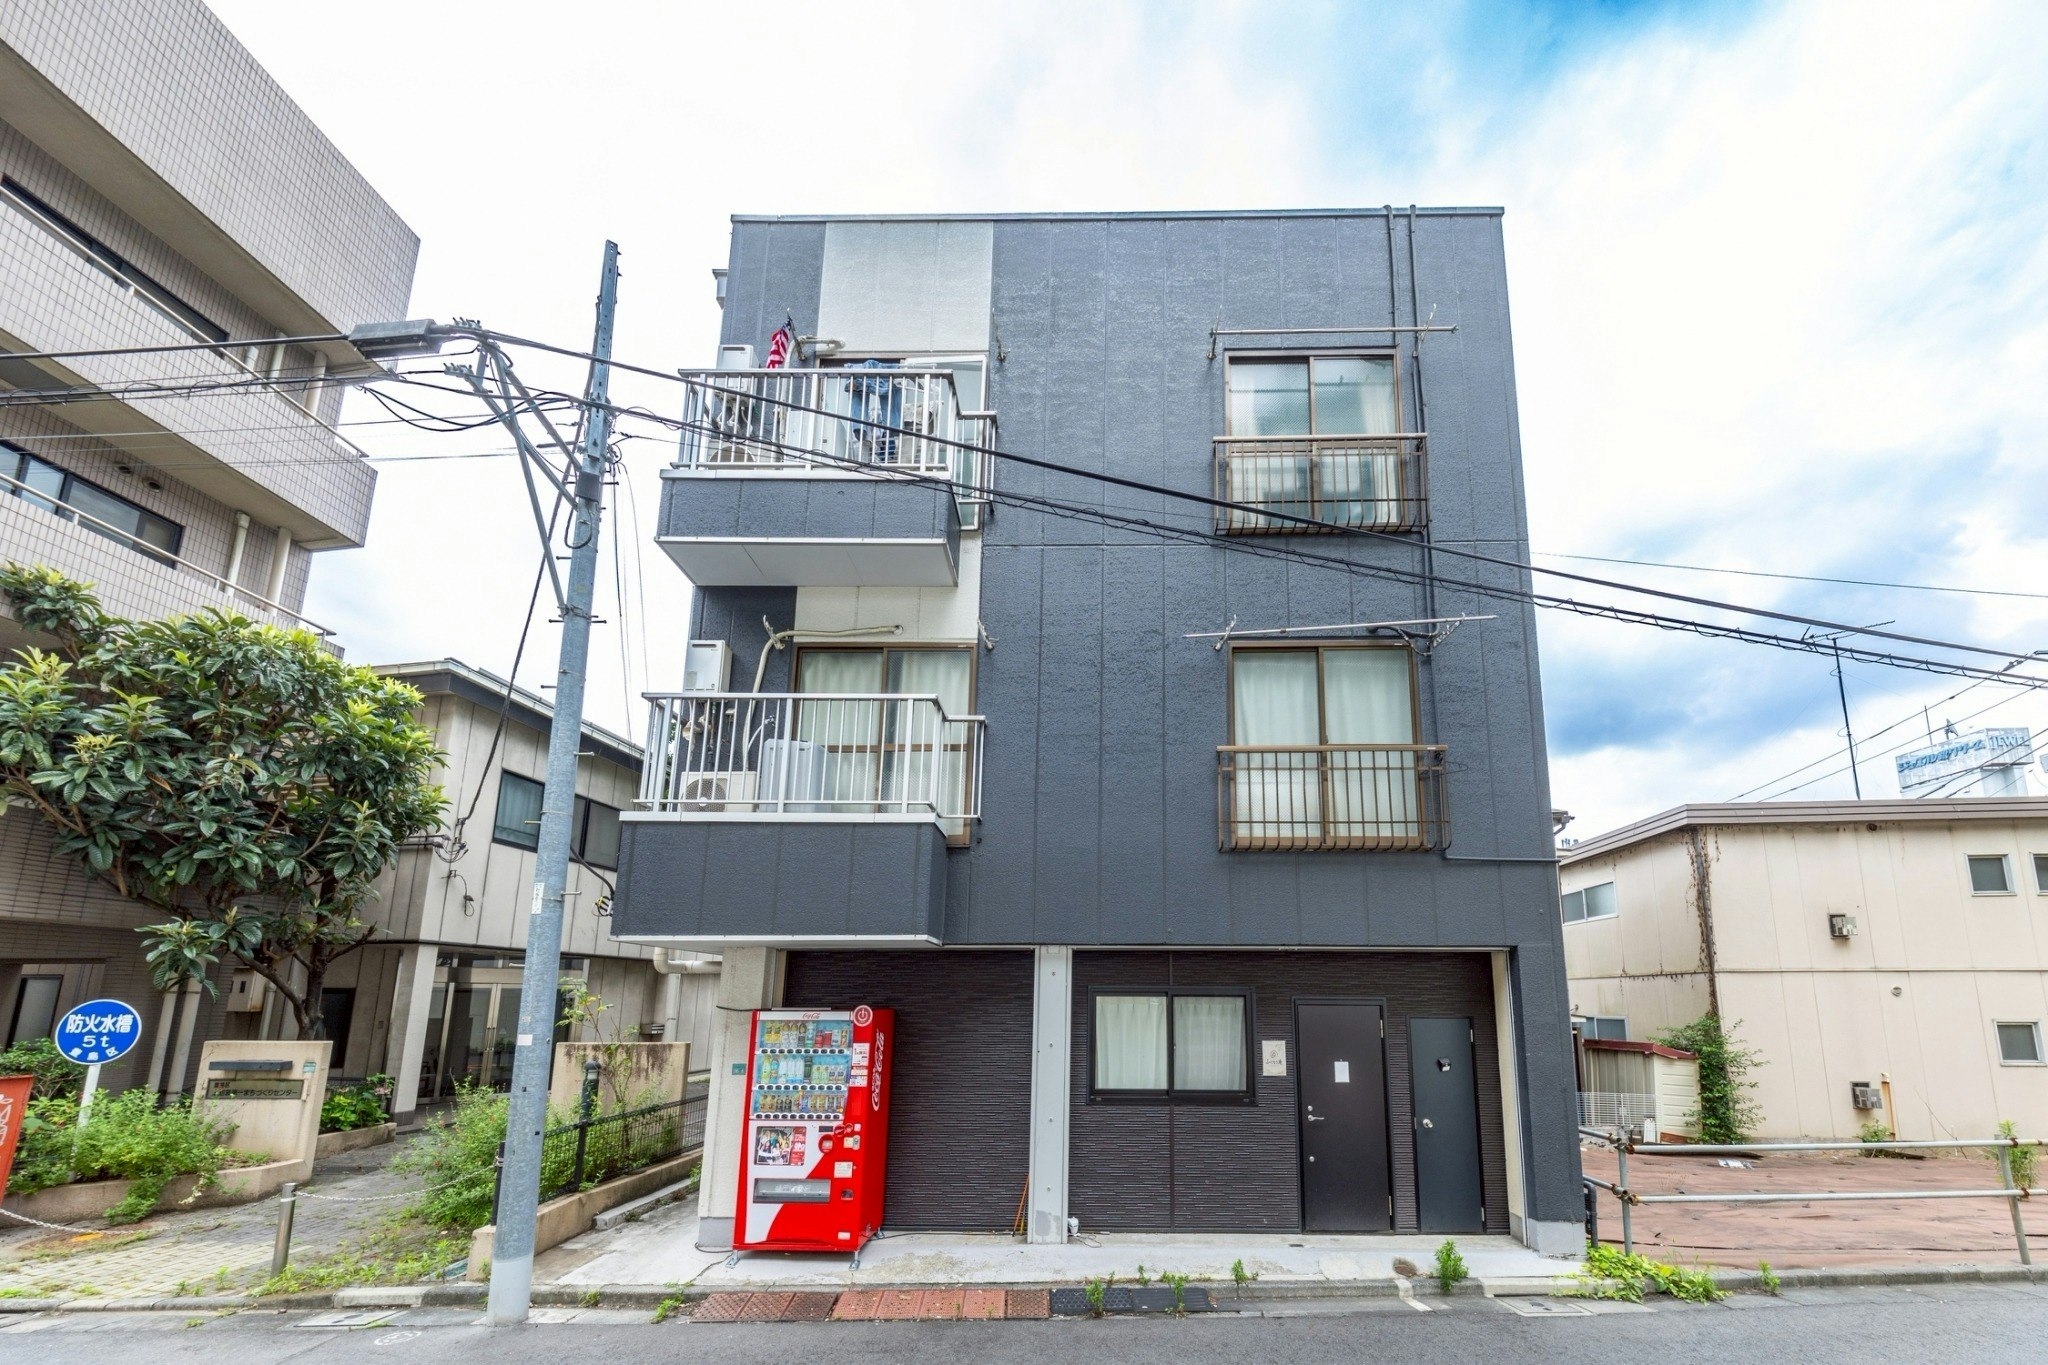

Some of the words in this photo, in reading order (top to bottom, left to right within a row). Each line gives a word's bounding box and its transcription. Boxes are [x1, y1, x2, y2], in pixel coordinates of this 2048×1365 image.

[65, 1013, 134, 1034] 防火水槽
[871, 1028, 885, 1112] Coca-Cola
